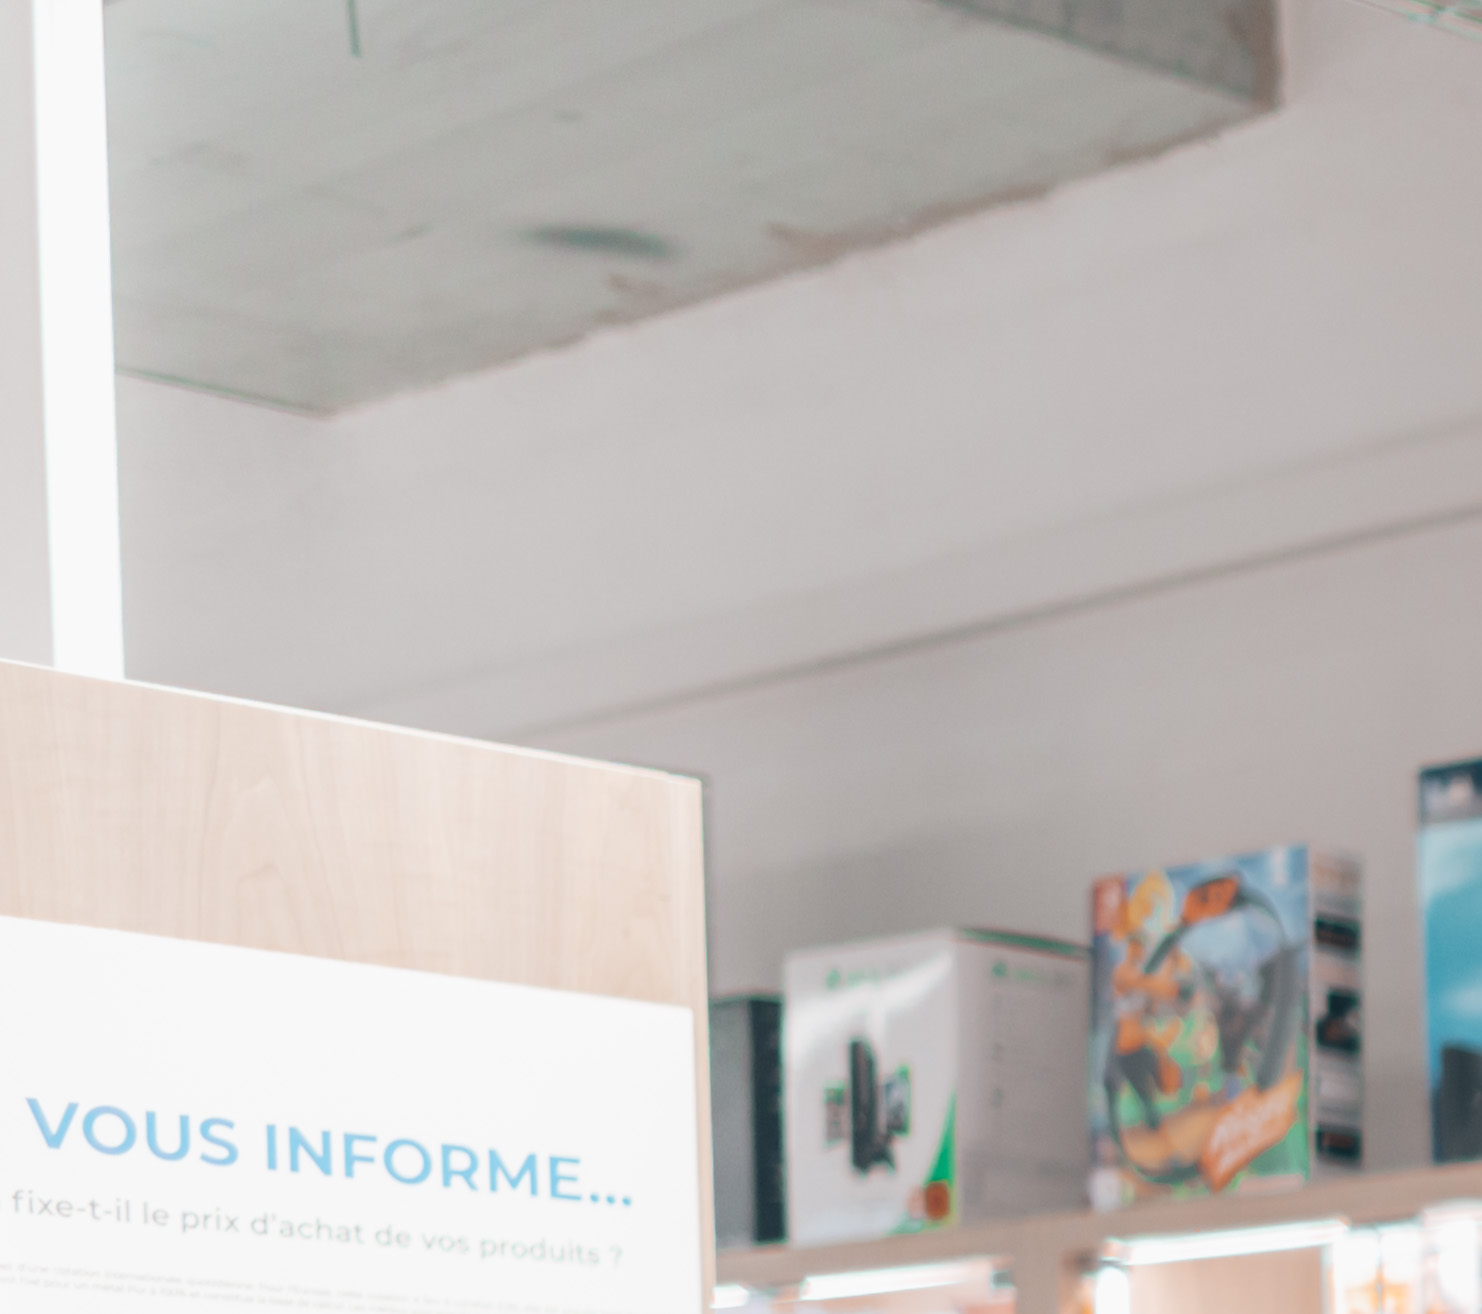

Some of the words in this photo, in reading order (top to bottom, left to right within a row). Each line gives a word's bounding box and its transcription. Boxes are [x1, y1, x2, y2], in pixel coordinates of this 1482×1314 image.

[25, 1097, 240, 1167] VOUS
[12, 1189, 132, 1224] fixe-t-il
[142, 1202, 170, 1228] le
[180, 1206, 241, 1236] prix
[250, 1213, 366, 1245] d'achat
[374, 1222, 413, 1249] de
[421, 1231, 471, 1254] vos
[479, 1233, 601, 1267] produits
